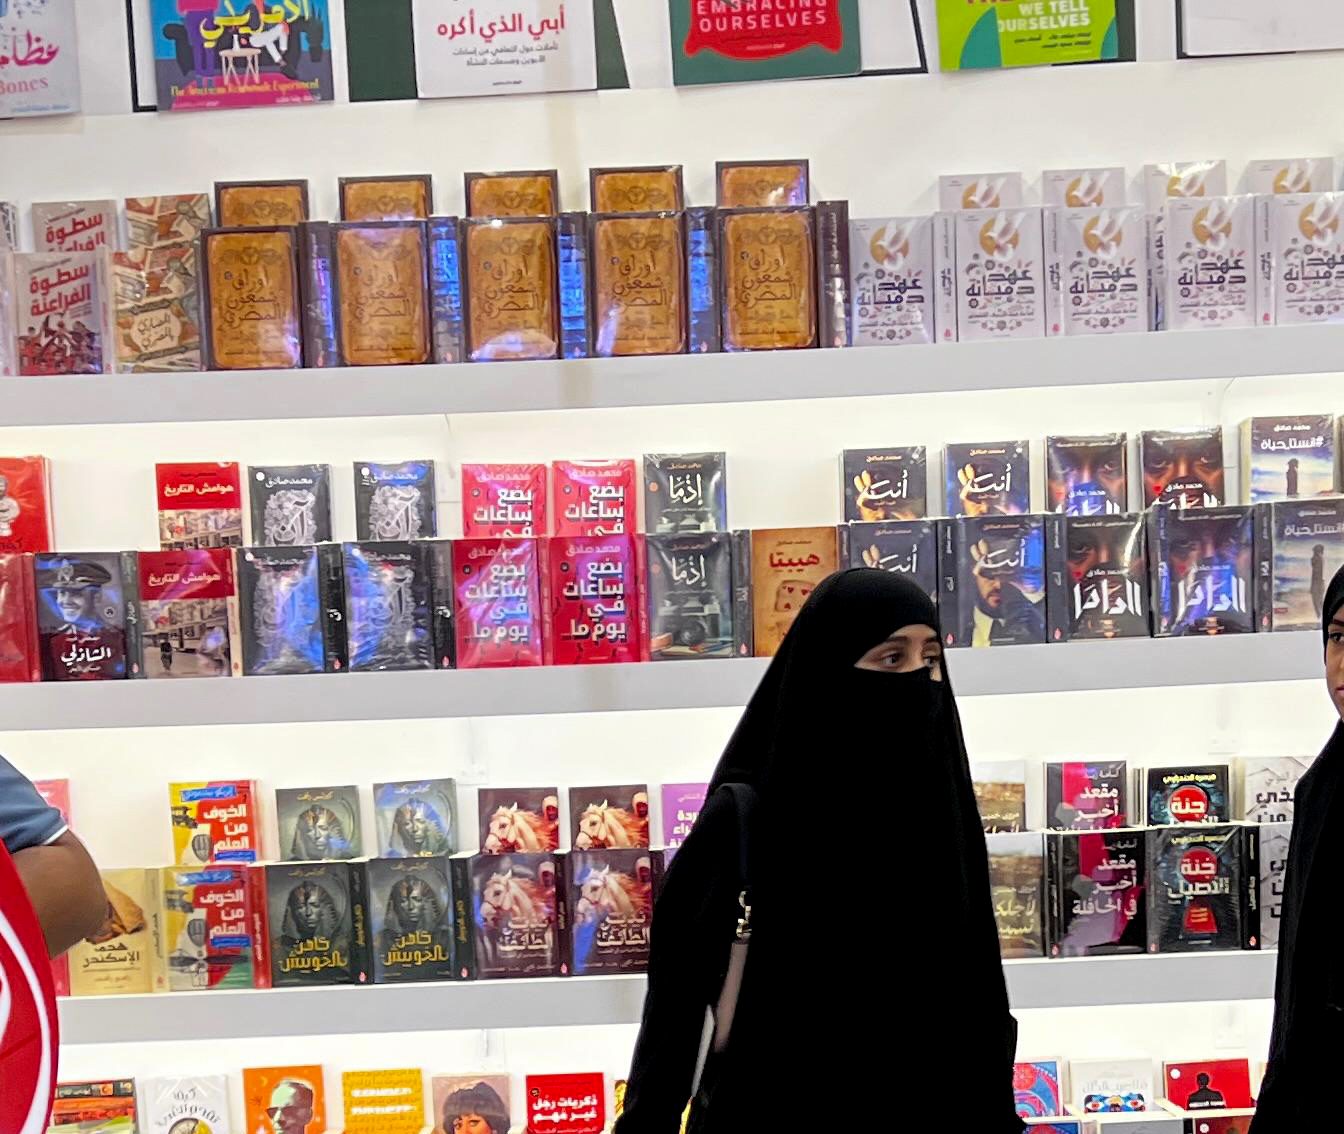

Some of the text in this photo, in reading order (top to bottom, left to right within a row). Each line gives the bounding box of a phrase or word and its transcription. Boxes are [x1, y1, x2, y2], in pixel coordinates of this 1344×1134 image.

[1019, 0, 1089, 16] WE TELL
[437, 4, 565, 43] أبي الذي أكره
[699, 10, 826, 33] OURSELVES
[998, 13, 1090, 32] OURSELVES
[45, 211, 103, 244] سطوة
[30, 264, 89, 293] سطوة
[31, 284, 91, 316] الفراعنة
[163, 481, 235, 498] هوامش التاريخ
[495, 486, 533, 505] بضع
[587, 483, 624, 503] بضع
[472, 504, 533, 525] ساعات
[564, 501, 624, 522] ساعات
[488, 561, 526, 582] بضع
[585, 557, 624, 578] بضع
[769, 551, 821, 573] هيبتا
[147, 571, 221, 587] هوامش التاريخ
[561, 578, 624, 598] ساعات
[464, 580, 527, 601] ساعات
[1073, 575, 1142, 618] الداما
[1177, 571, 1246, 615] الداما
[490, 599, 528, 620] في
[587, 596, 625, 617] في
[494, 621, 528, 644] يوم
[591, 619, 627, 641] يوم
[61, 646, 112, 666] الشاذلي
[1079, 785, 1119, 800] مقعد
[203, 804, 247, 821] الخوف
[224, 821, 248, 835] من
[200, 889, 244, 906] الخوف
[220, 907, 245, 921] من
[531, 1093, 598, 1111] ذكريات رجل
